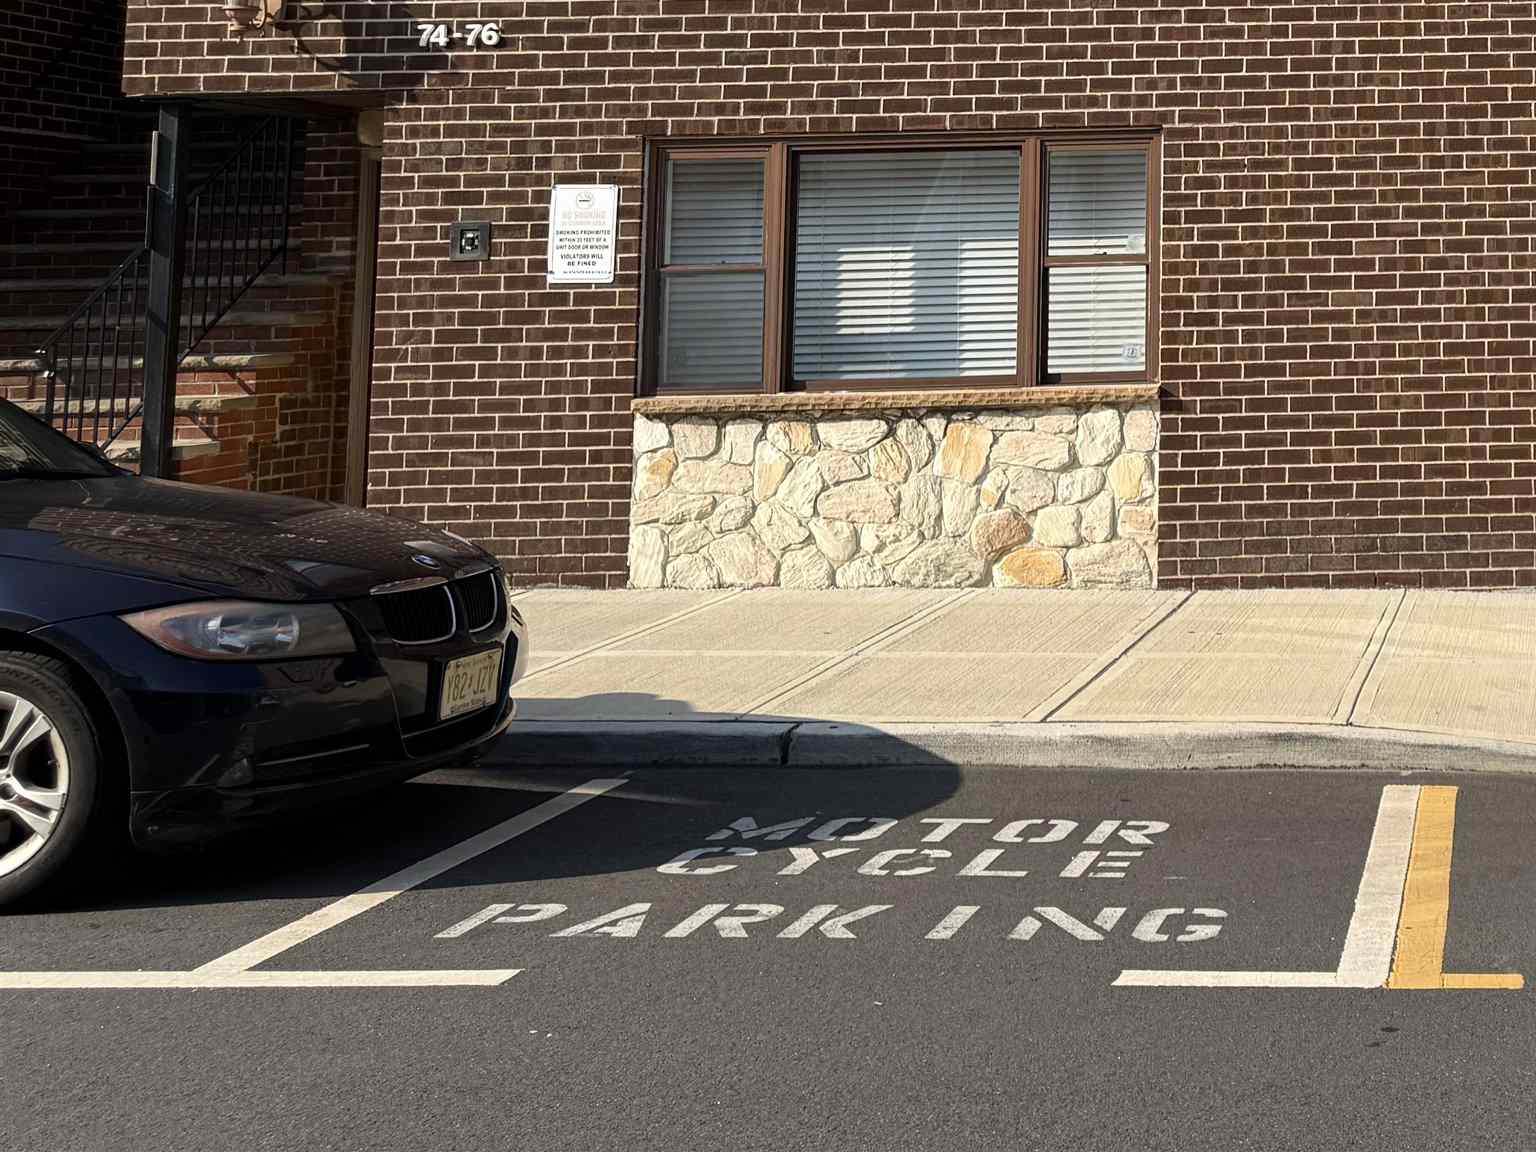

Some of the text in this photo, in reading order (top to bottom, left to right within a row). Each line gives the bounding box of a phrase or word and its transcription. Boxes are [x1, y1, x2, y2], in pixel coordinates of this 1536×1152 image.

[417, 22, 499, 47] 74-76
[704, 816, 1170, 845] MOTOR
[656, 847, 1144, 877] CYCLE
[433, 903, 1228, 942] PARKING
